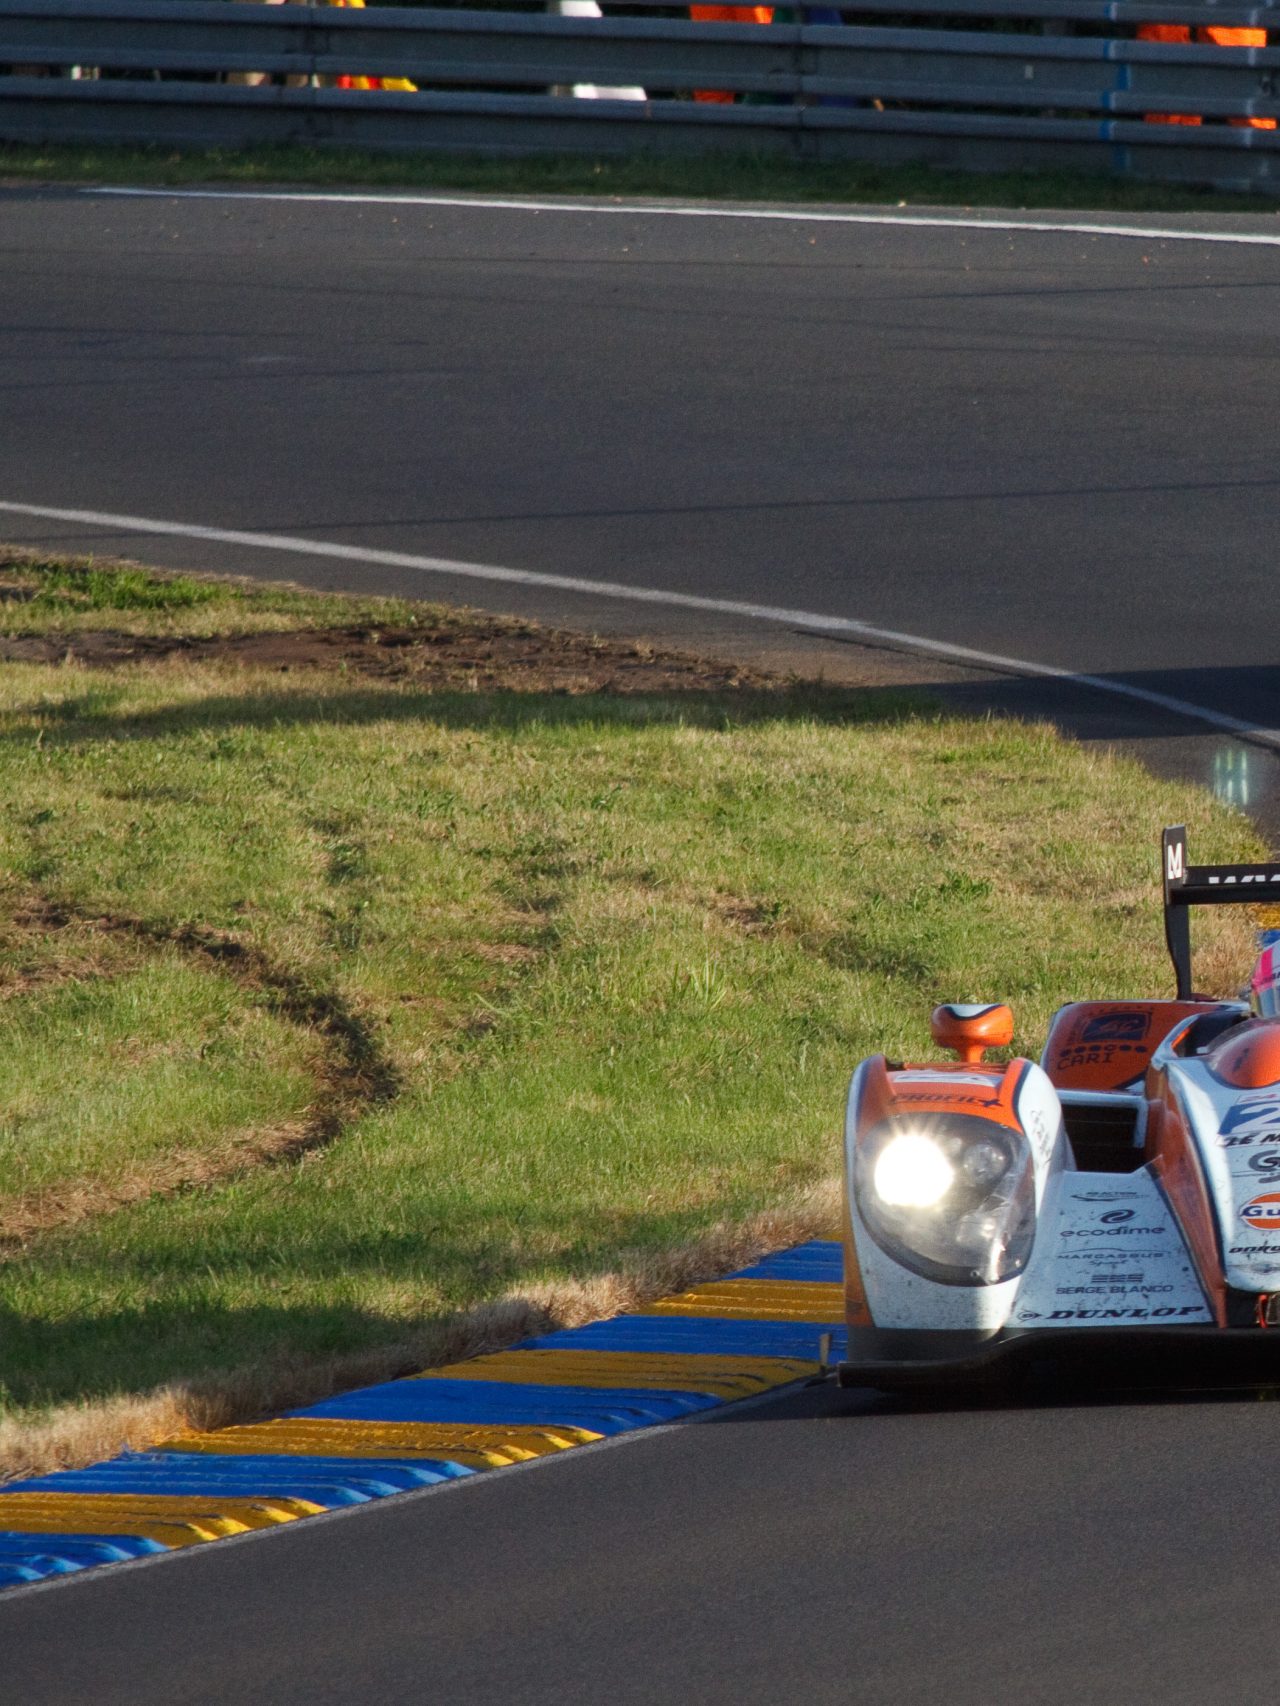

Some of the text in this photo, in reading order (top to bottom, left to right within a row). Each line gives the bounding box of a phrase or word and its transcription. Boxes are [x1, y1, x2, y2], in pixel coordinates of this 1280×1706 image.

[1060, 1226, 1166, 1238] ecodime
[1056, 1284, 1175, 1295] SERGE BLANCO
[1046, 1306, 1205, 1320] DUNLOP
